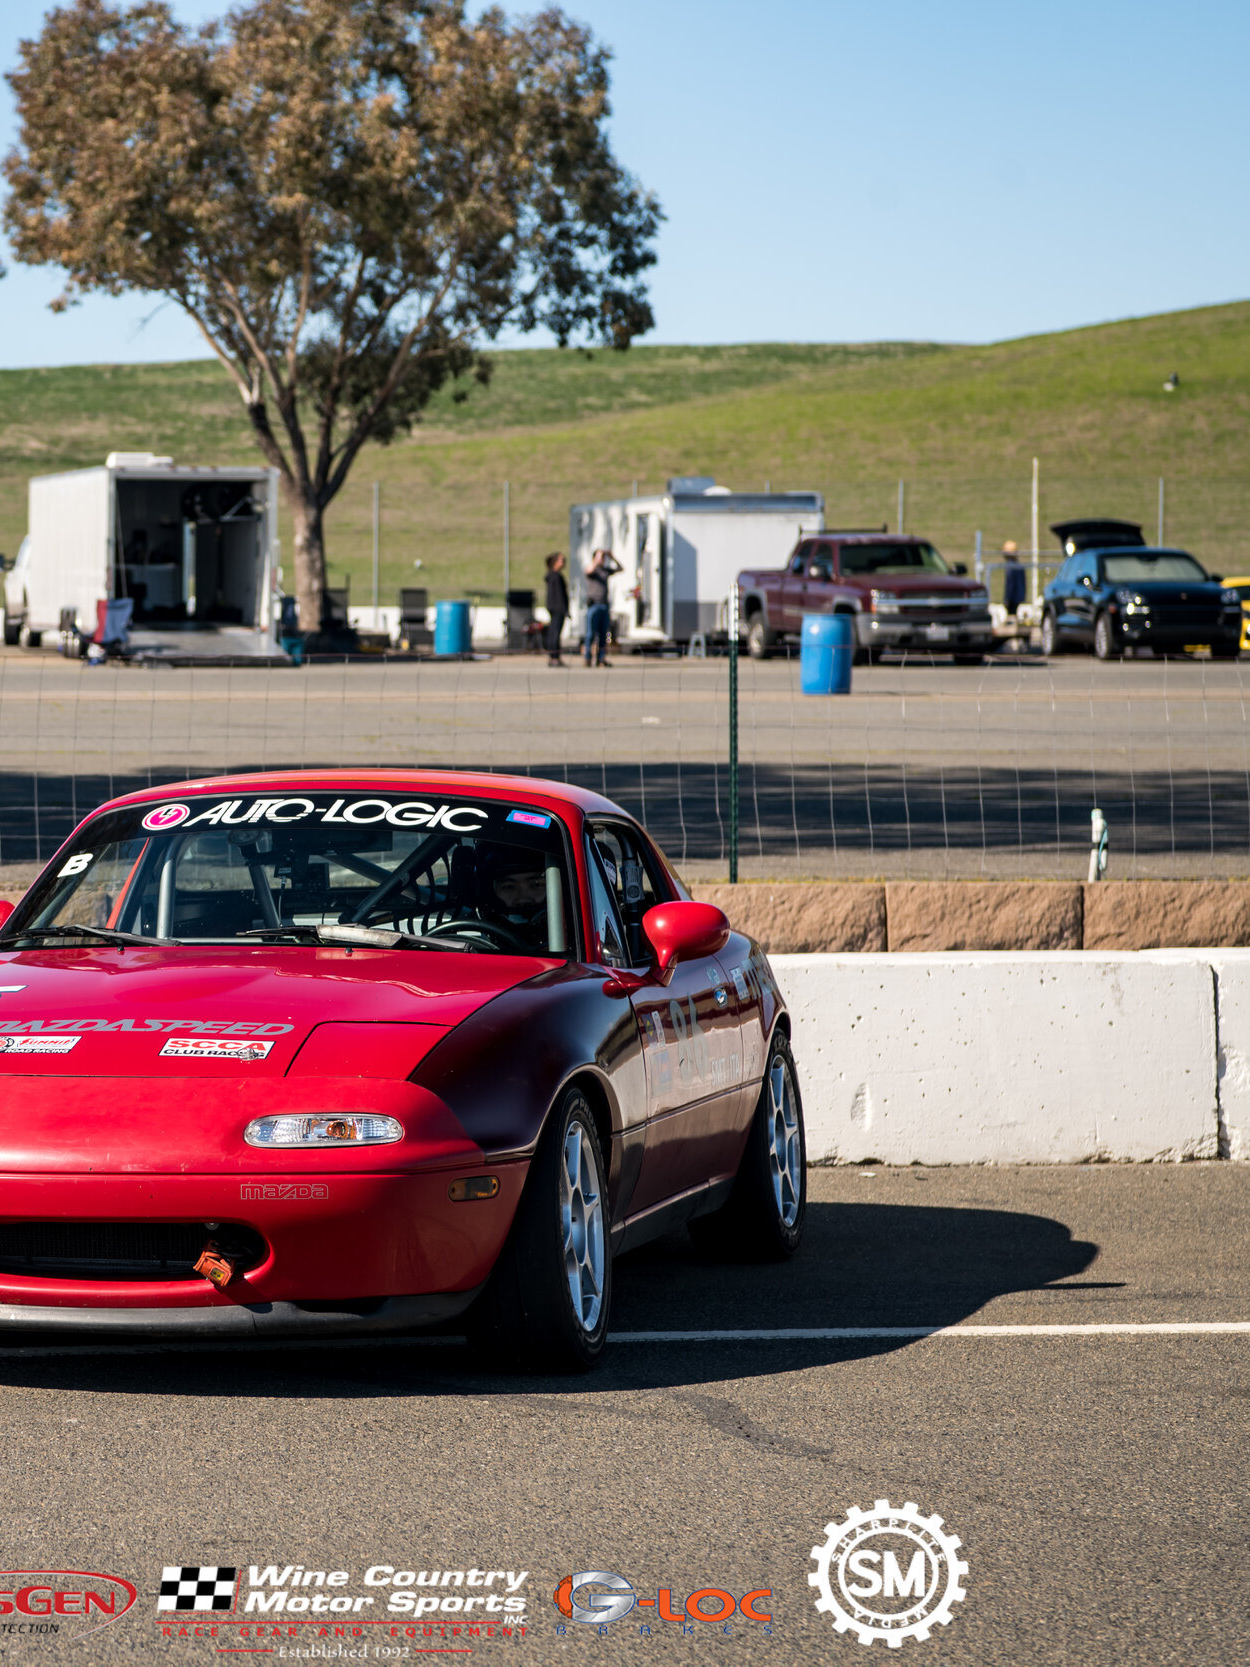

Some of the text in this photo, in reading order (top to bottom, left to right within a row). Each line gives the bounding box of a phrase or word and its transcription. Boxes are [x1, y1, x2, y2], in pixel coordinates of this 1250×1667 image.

[182, 798, 489, 832] AUTO-LOGIC
[57, 853, 94, 877] B
[168, 1040, 266, 1051] SCCA
[207, 1049, 265, 1058] RACG
